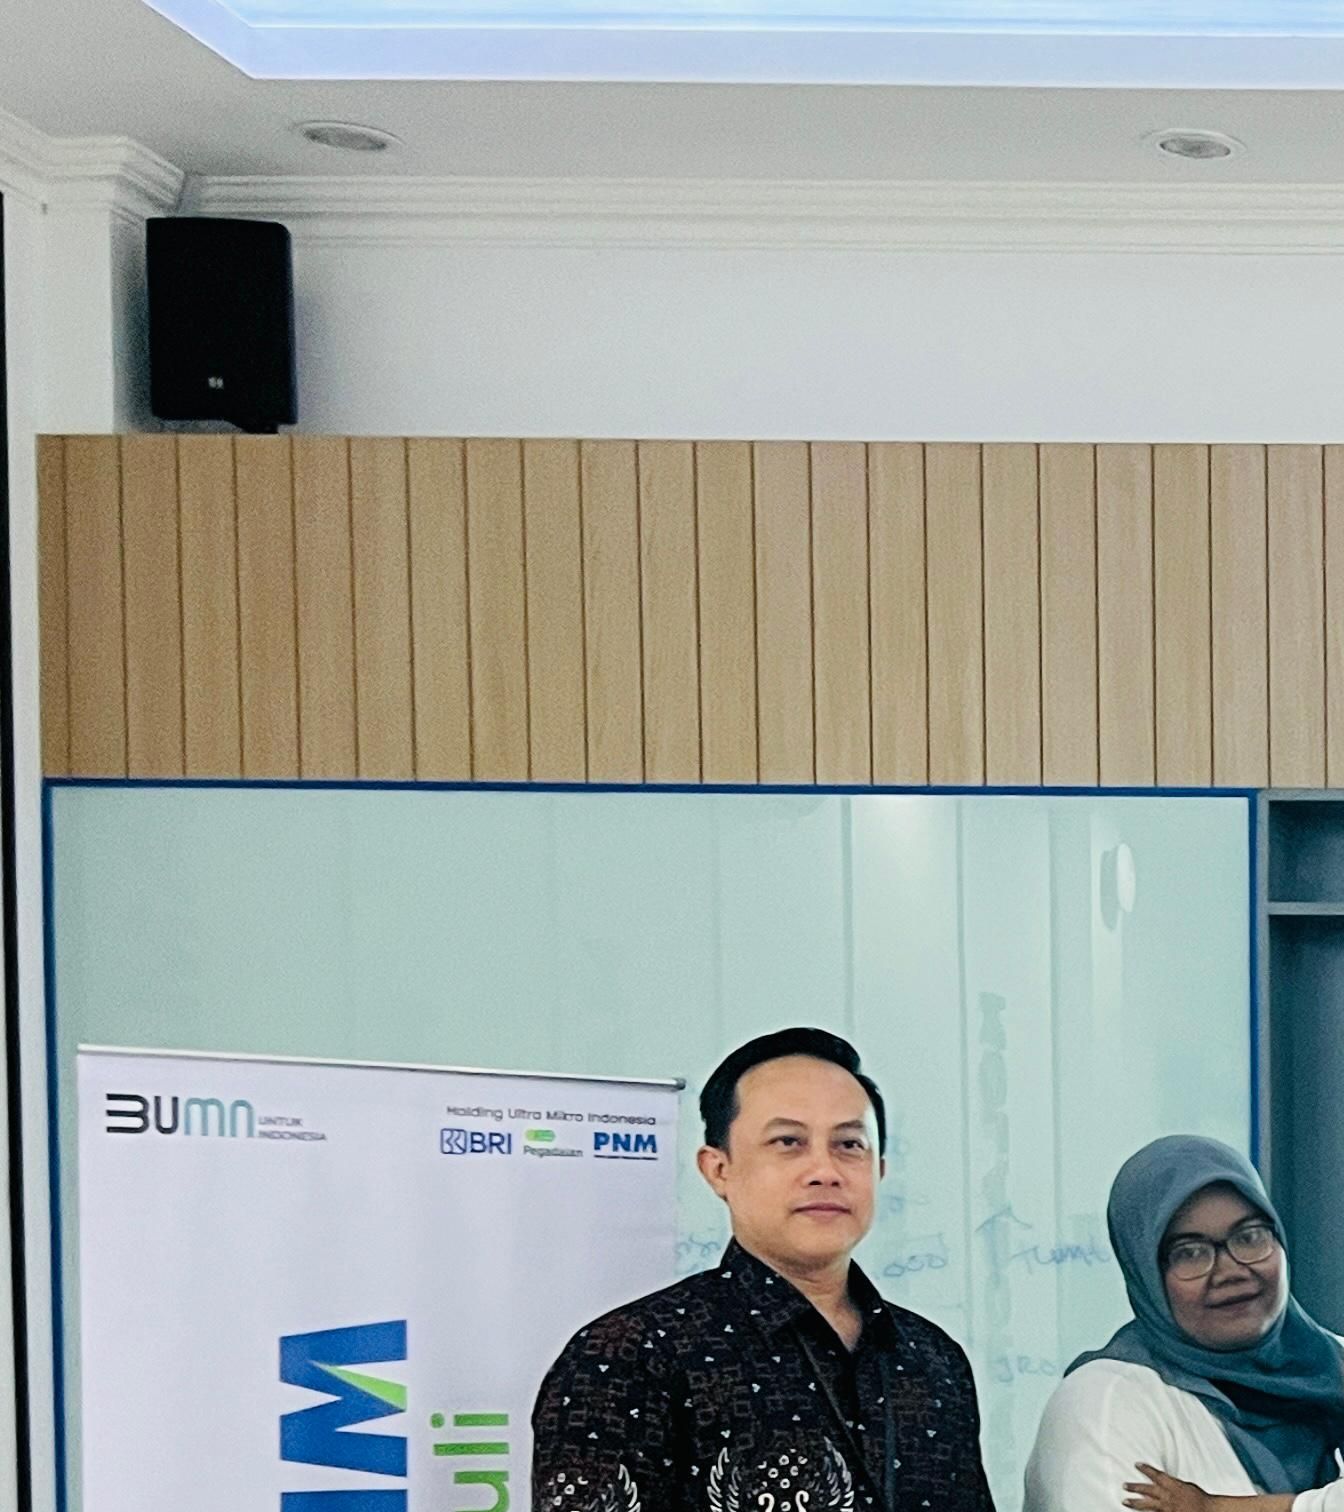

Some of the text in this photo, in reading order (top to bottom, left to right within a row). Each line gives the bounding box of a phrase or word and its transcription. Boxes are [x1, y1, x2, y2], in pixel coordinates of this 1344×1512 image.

[447, 1106, 657, 1126] Holding Ultra Mikro Indonesia
[469, 1131, 513, 1155] BRI
[593, 1131, 658, 1154] PNM
